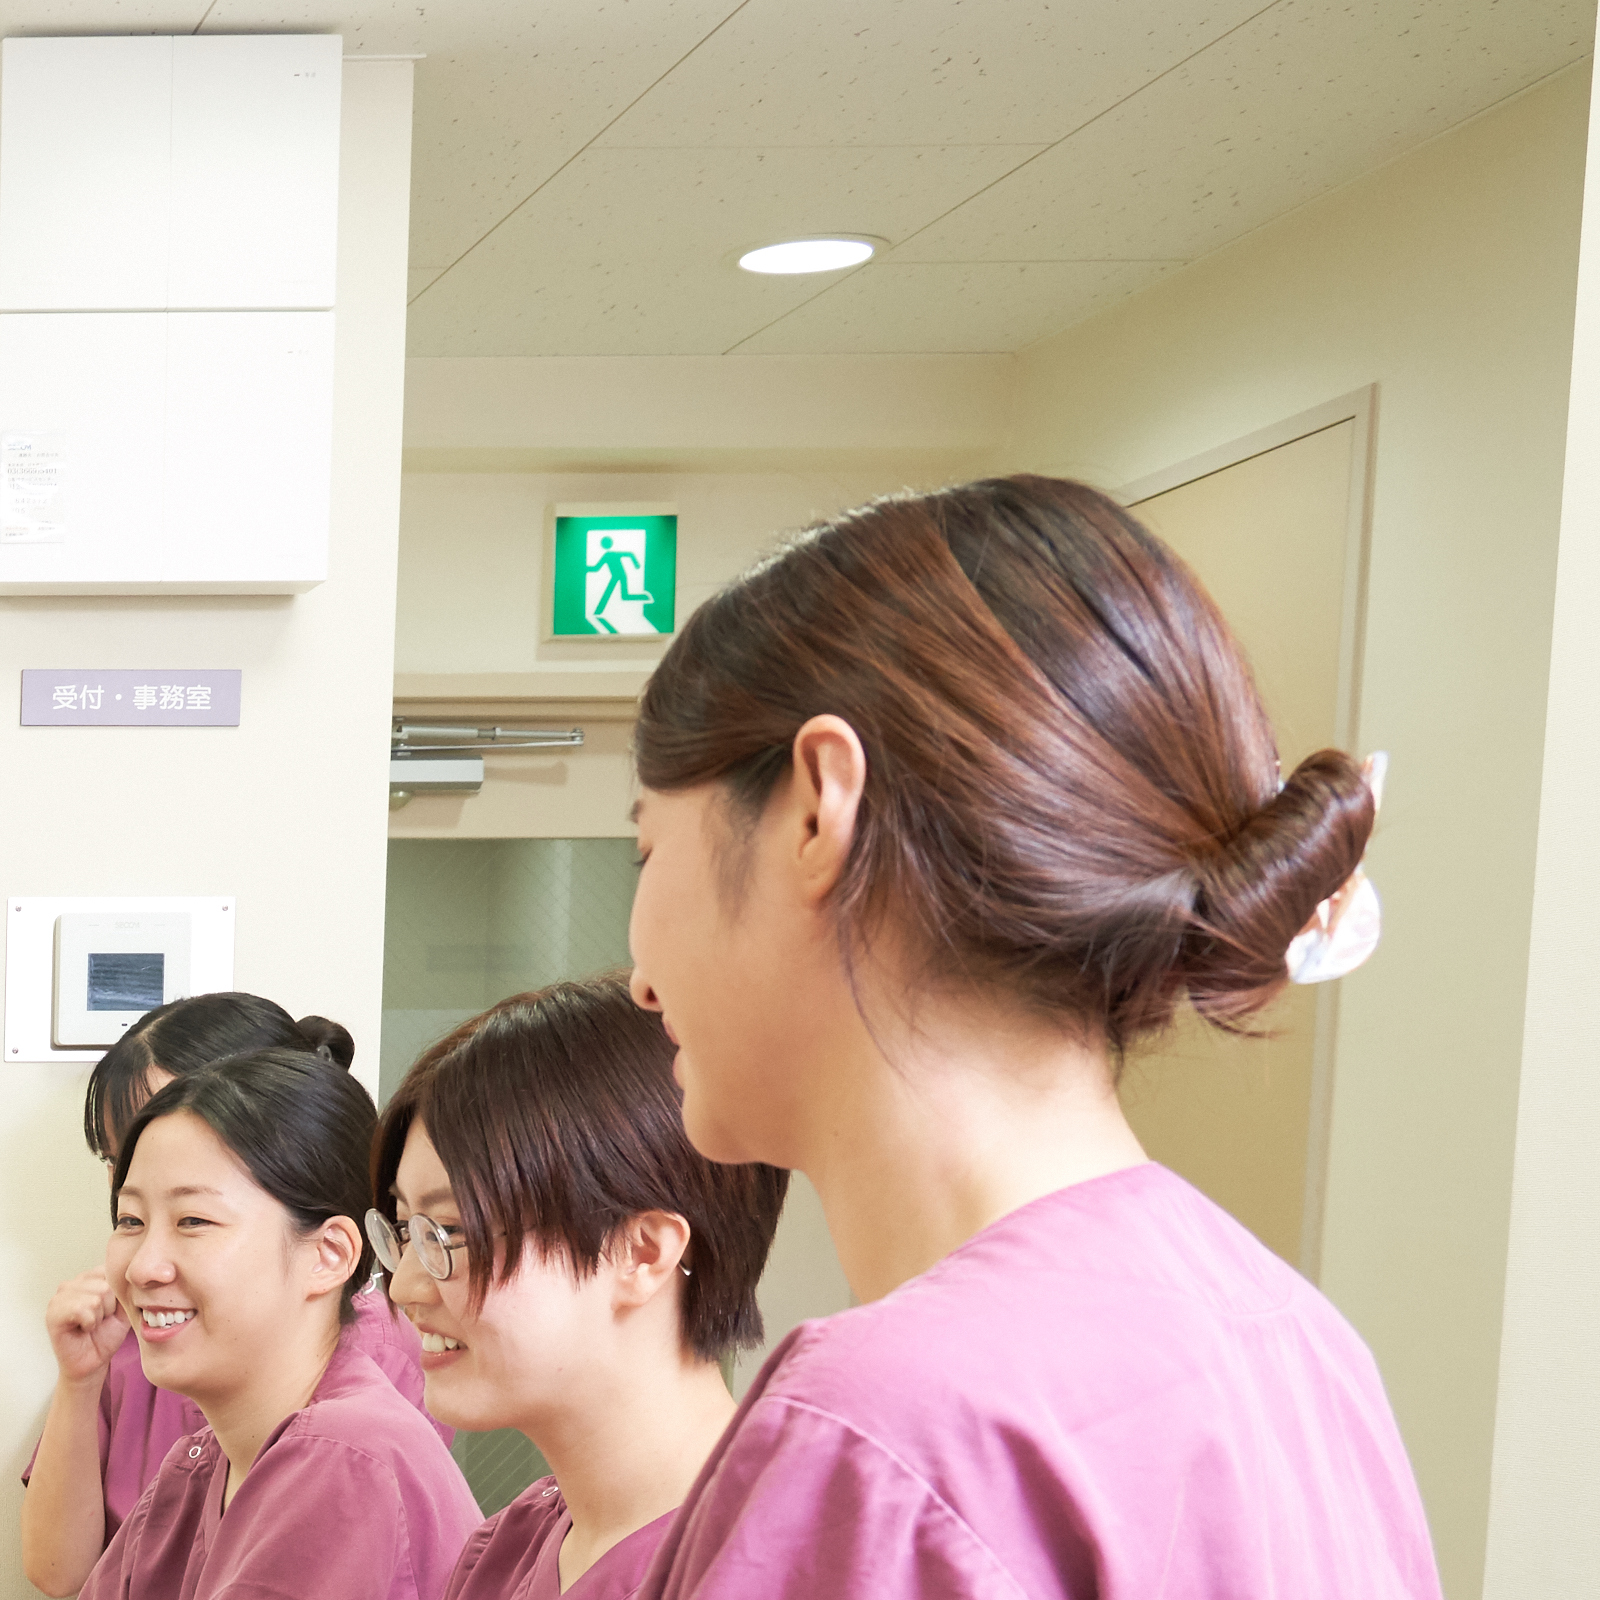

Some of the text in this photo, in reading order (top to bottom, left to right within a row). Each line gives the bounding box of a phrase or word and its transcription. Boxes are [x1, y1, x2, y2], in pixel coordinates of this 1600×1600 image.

[51, 685, 212, 711] 受付・事務室
